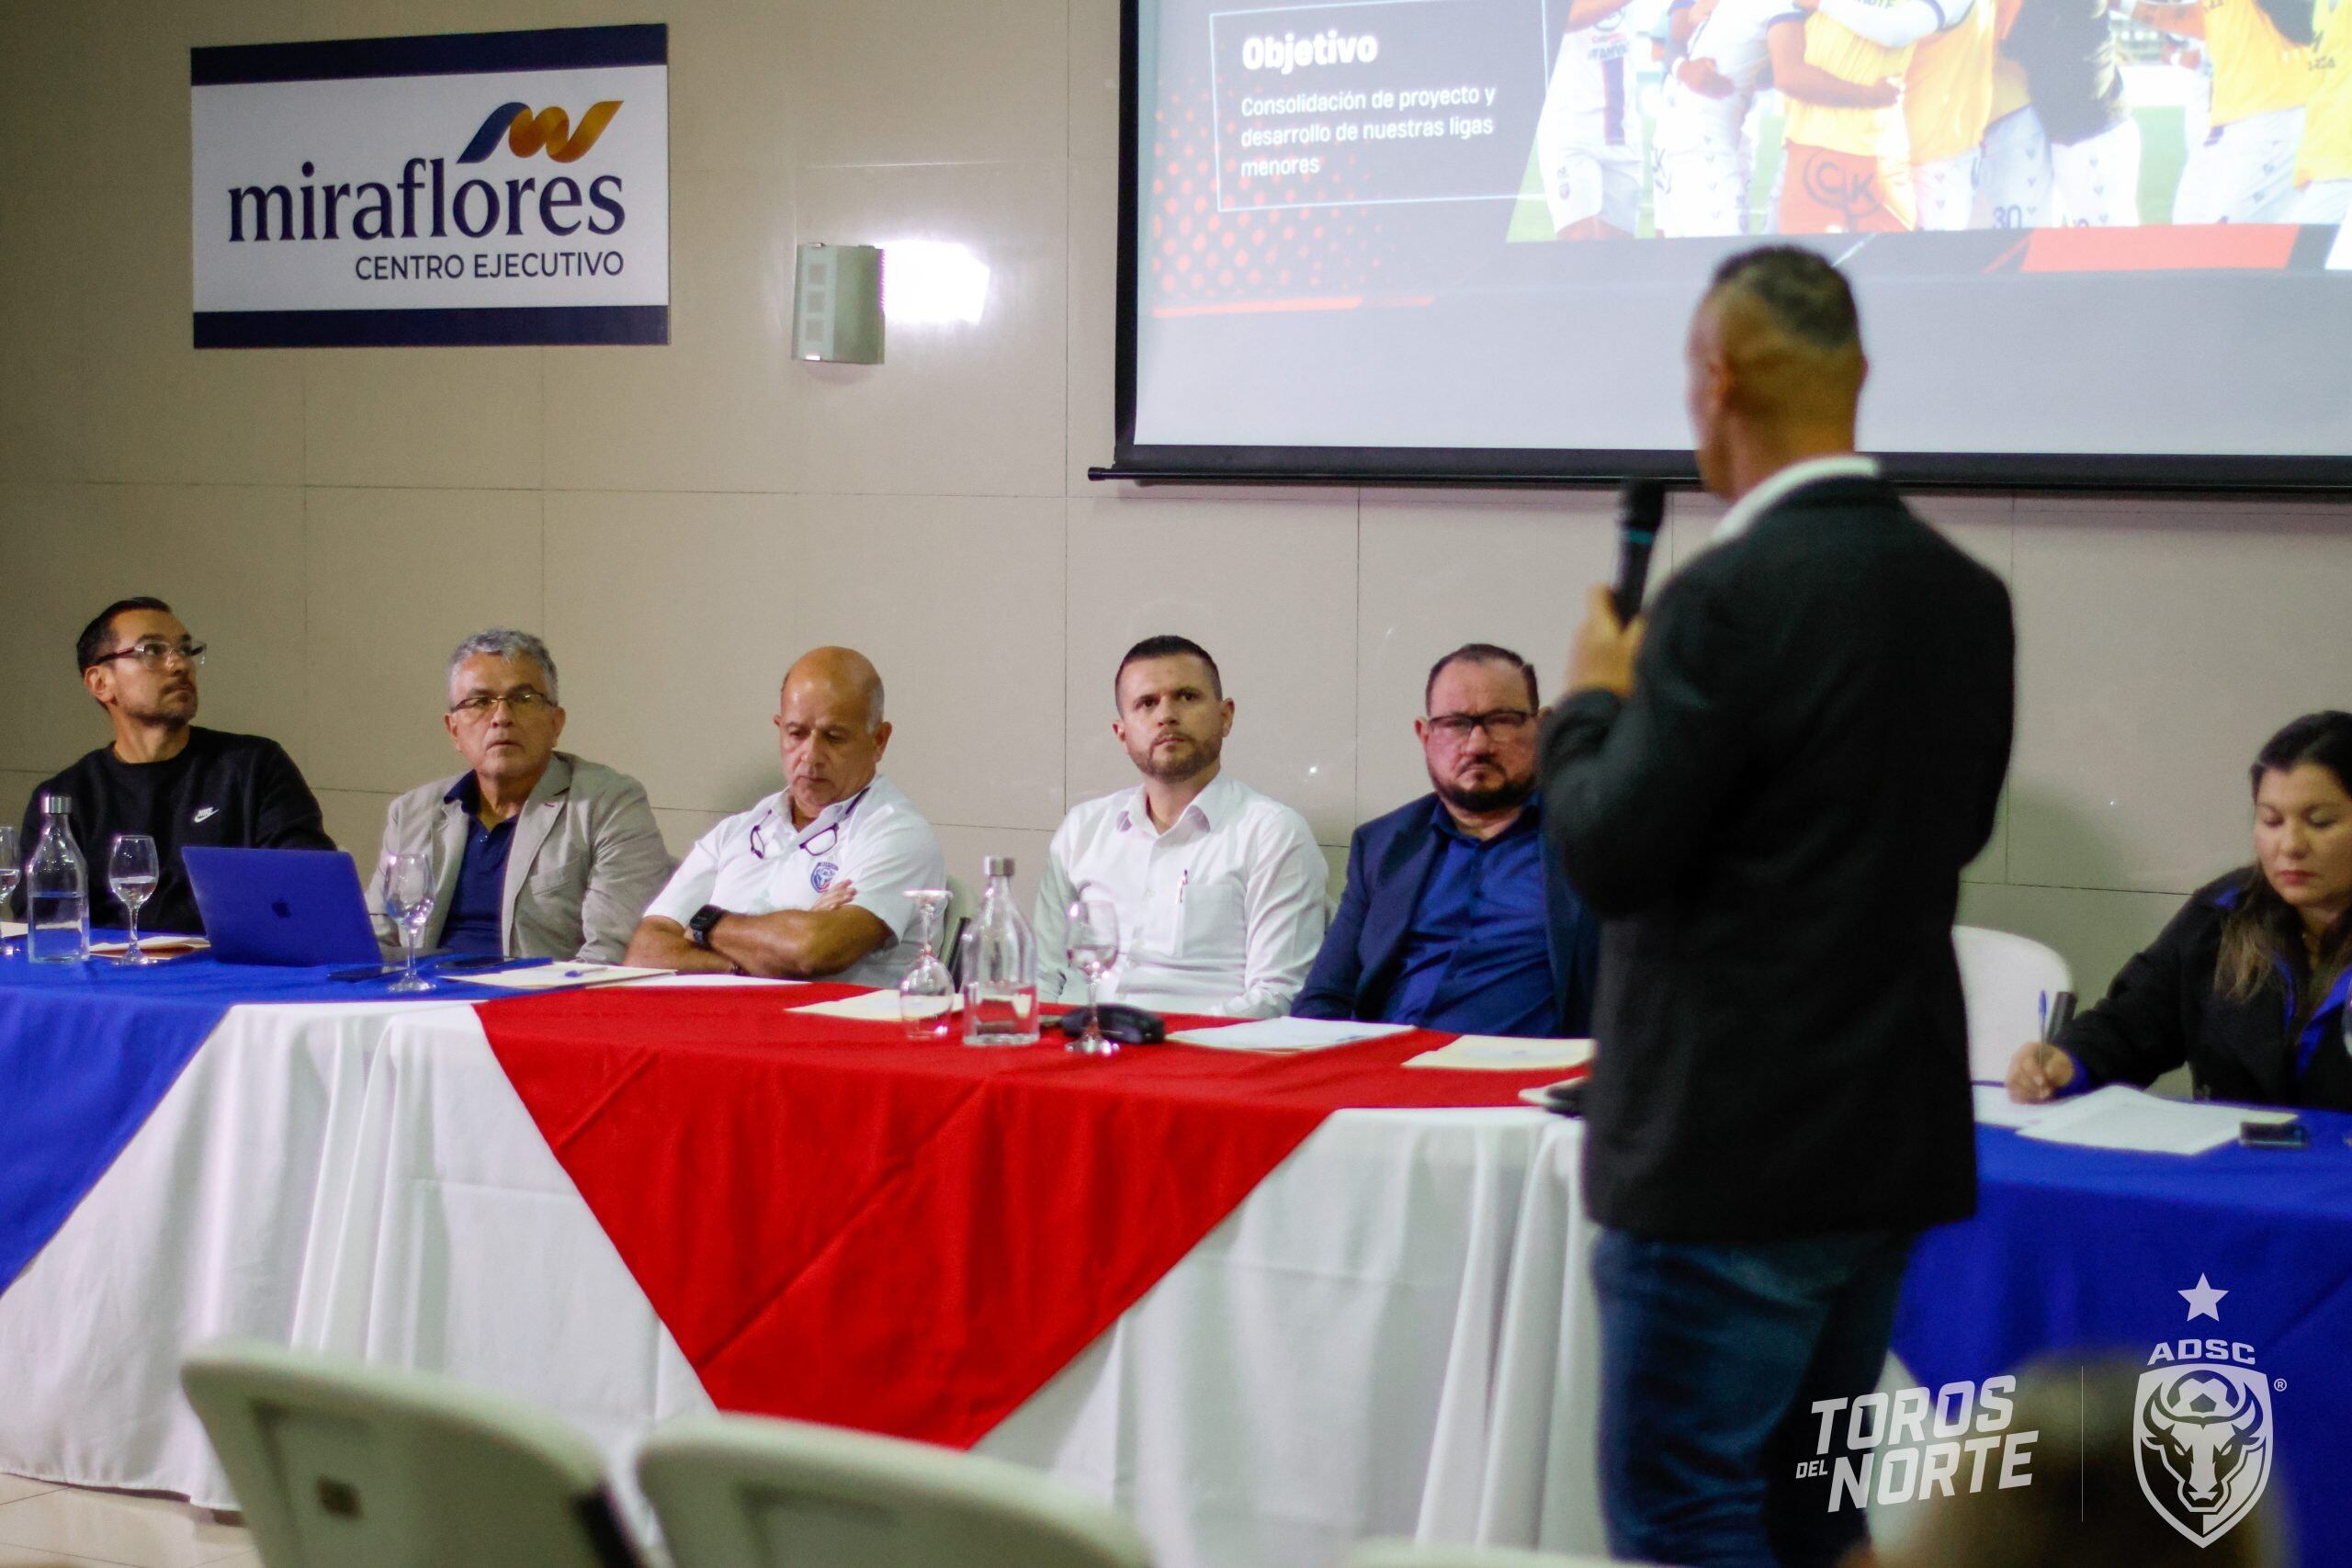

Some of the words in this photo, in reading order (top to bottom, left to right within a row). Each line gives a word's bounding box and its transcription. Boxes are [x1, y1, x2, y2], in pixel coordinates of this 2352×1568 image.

[1242, 29, 1378, 75] Objetivo
[1240, 89, 1367, 117] Consolidación
[1371, 89, 1395, 109] de
[1398, 86, 1480, 111] proyecto
[1485, 86, 1497, 107] y
[1240, 123, 1332, 148] desarrollo
[1335, 122, 1359, 141] de
[1363, 118, 1444, 140] nuestras
[1449, 116, 1494, 140] ligas
[1240, 156, 1320, 177] menores
[228, 157, 626, 243] miraflores
[355, 254, 465, 280] CENTRO
[474, 251, 625, 278] EJECUTIVO
